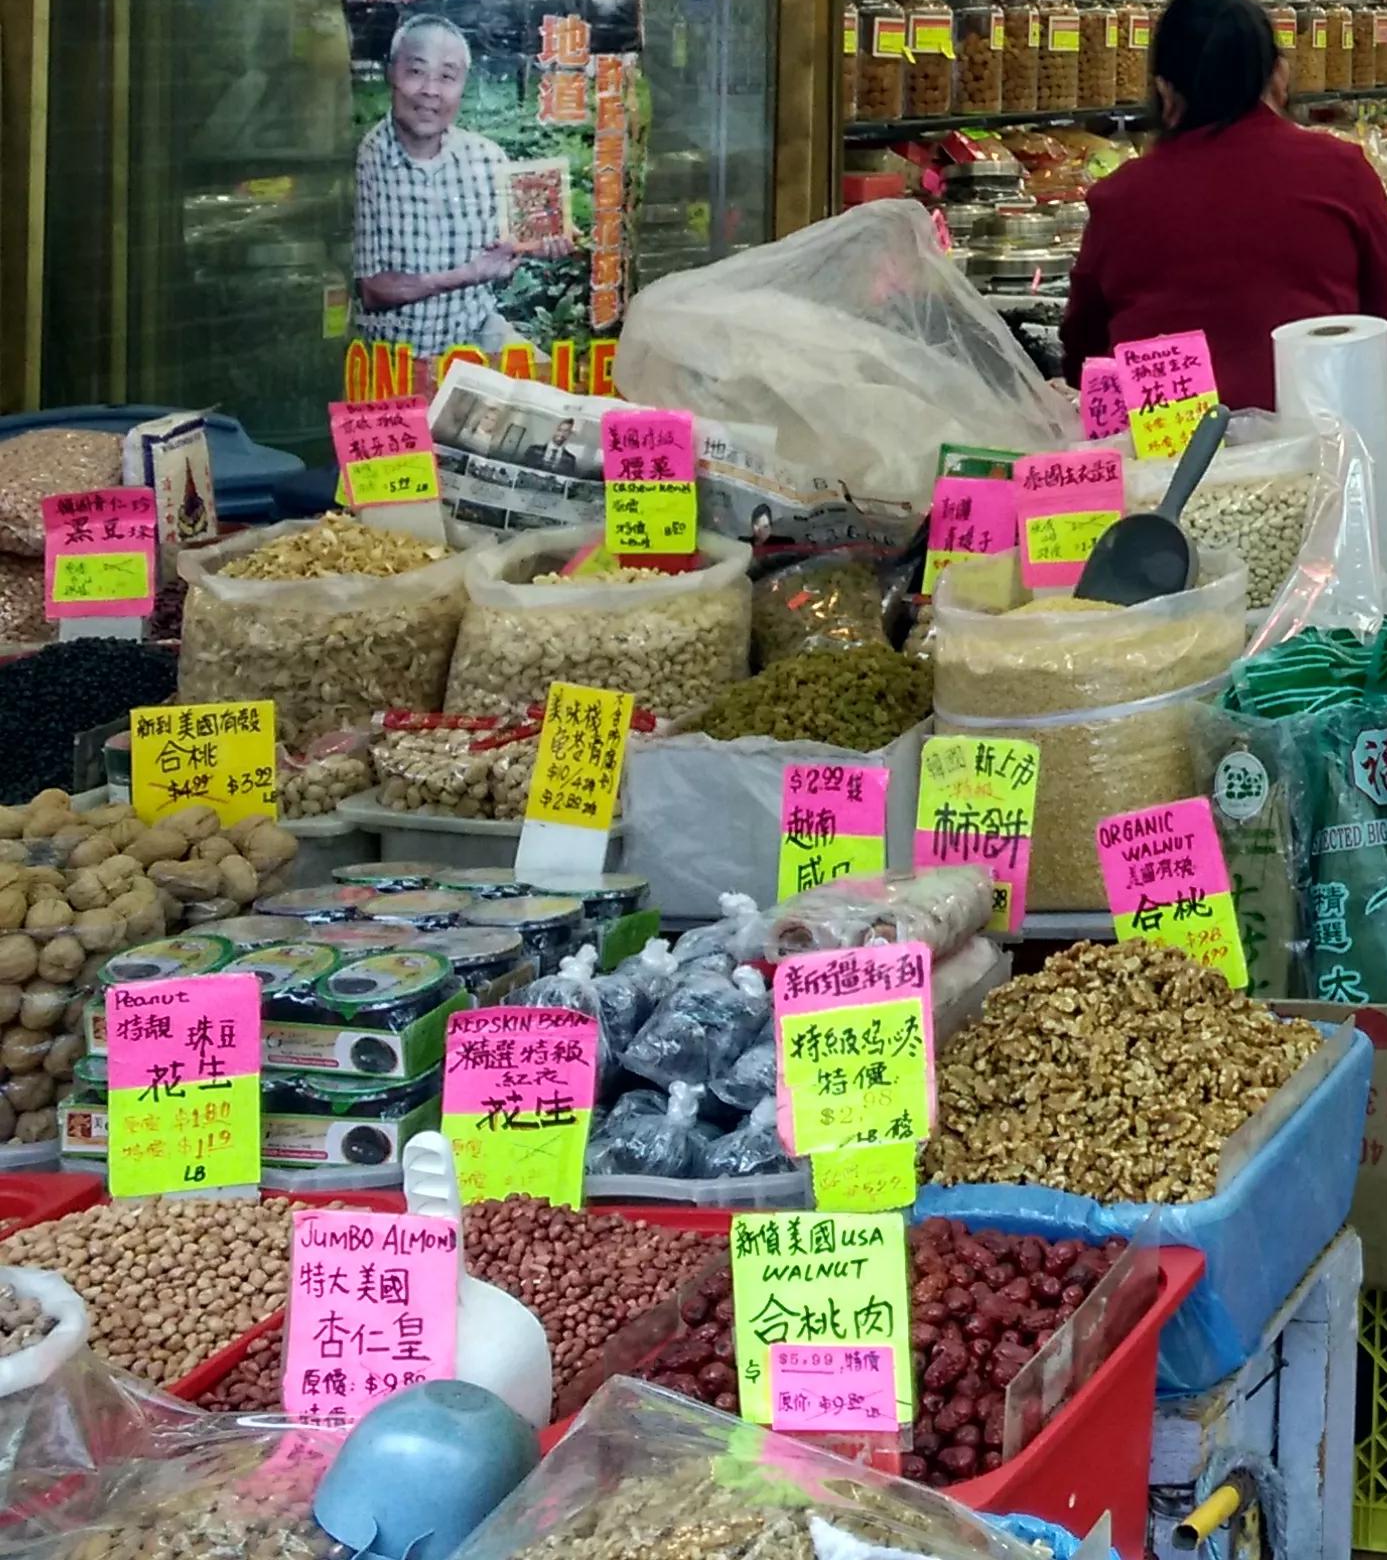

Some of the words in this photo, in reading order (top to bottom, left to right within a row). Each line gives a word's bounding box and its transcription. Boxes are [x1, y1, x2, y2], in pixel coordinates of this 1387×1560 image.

[537, 13, 592, 125] 地道
[346, 338, 413, 402] ON
[1139, 375, 1200, 416] 花生
[155, 740, 219, 773] 合桃
[974, 741, 1037, 790] 新上市
[785, 806, 836, 850] 越南
[932, 801, 1029, 870] 柿餅
[1099, 811, 1175, 849] ORGANIC
[1121, 833, 1196, 863] WALNUT
[1131, 886, 1214, 932] 合桃
[114, 988, 191, 1012] Peanut
[448, 1036, 591, 1074] 精選特級
[139, 1055, 234, 1104] 花生
[475, 1090, 578, 1132] 花生
[184, 1163, 208, 1184] LB
[299, 1217, 376, 1252] JUMBO
[381, 1222, 459, 1256] ALMOND
[735, 1215, 837, 1260] 新貨美國
[841, 1226, 885, 1247] USA
[299, 1264, 411, 1308] 特大美國
[761, 1257, 870, 1283] WALNUT
[312, 1310, 432, 1365] 杏仁皇
[748, 1292, 895, 1345] 合桃肉
